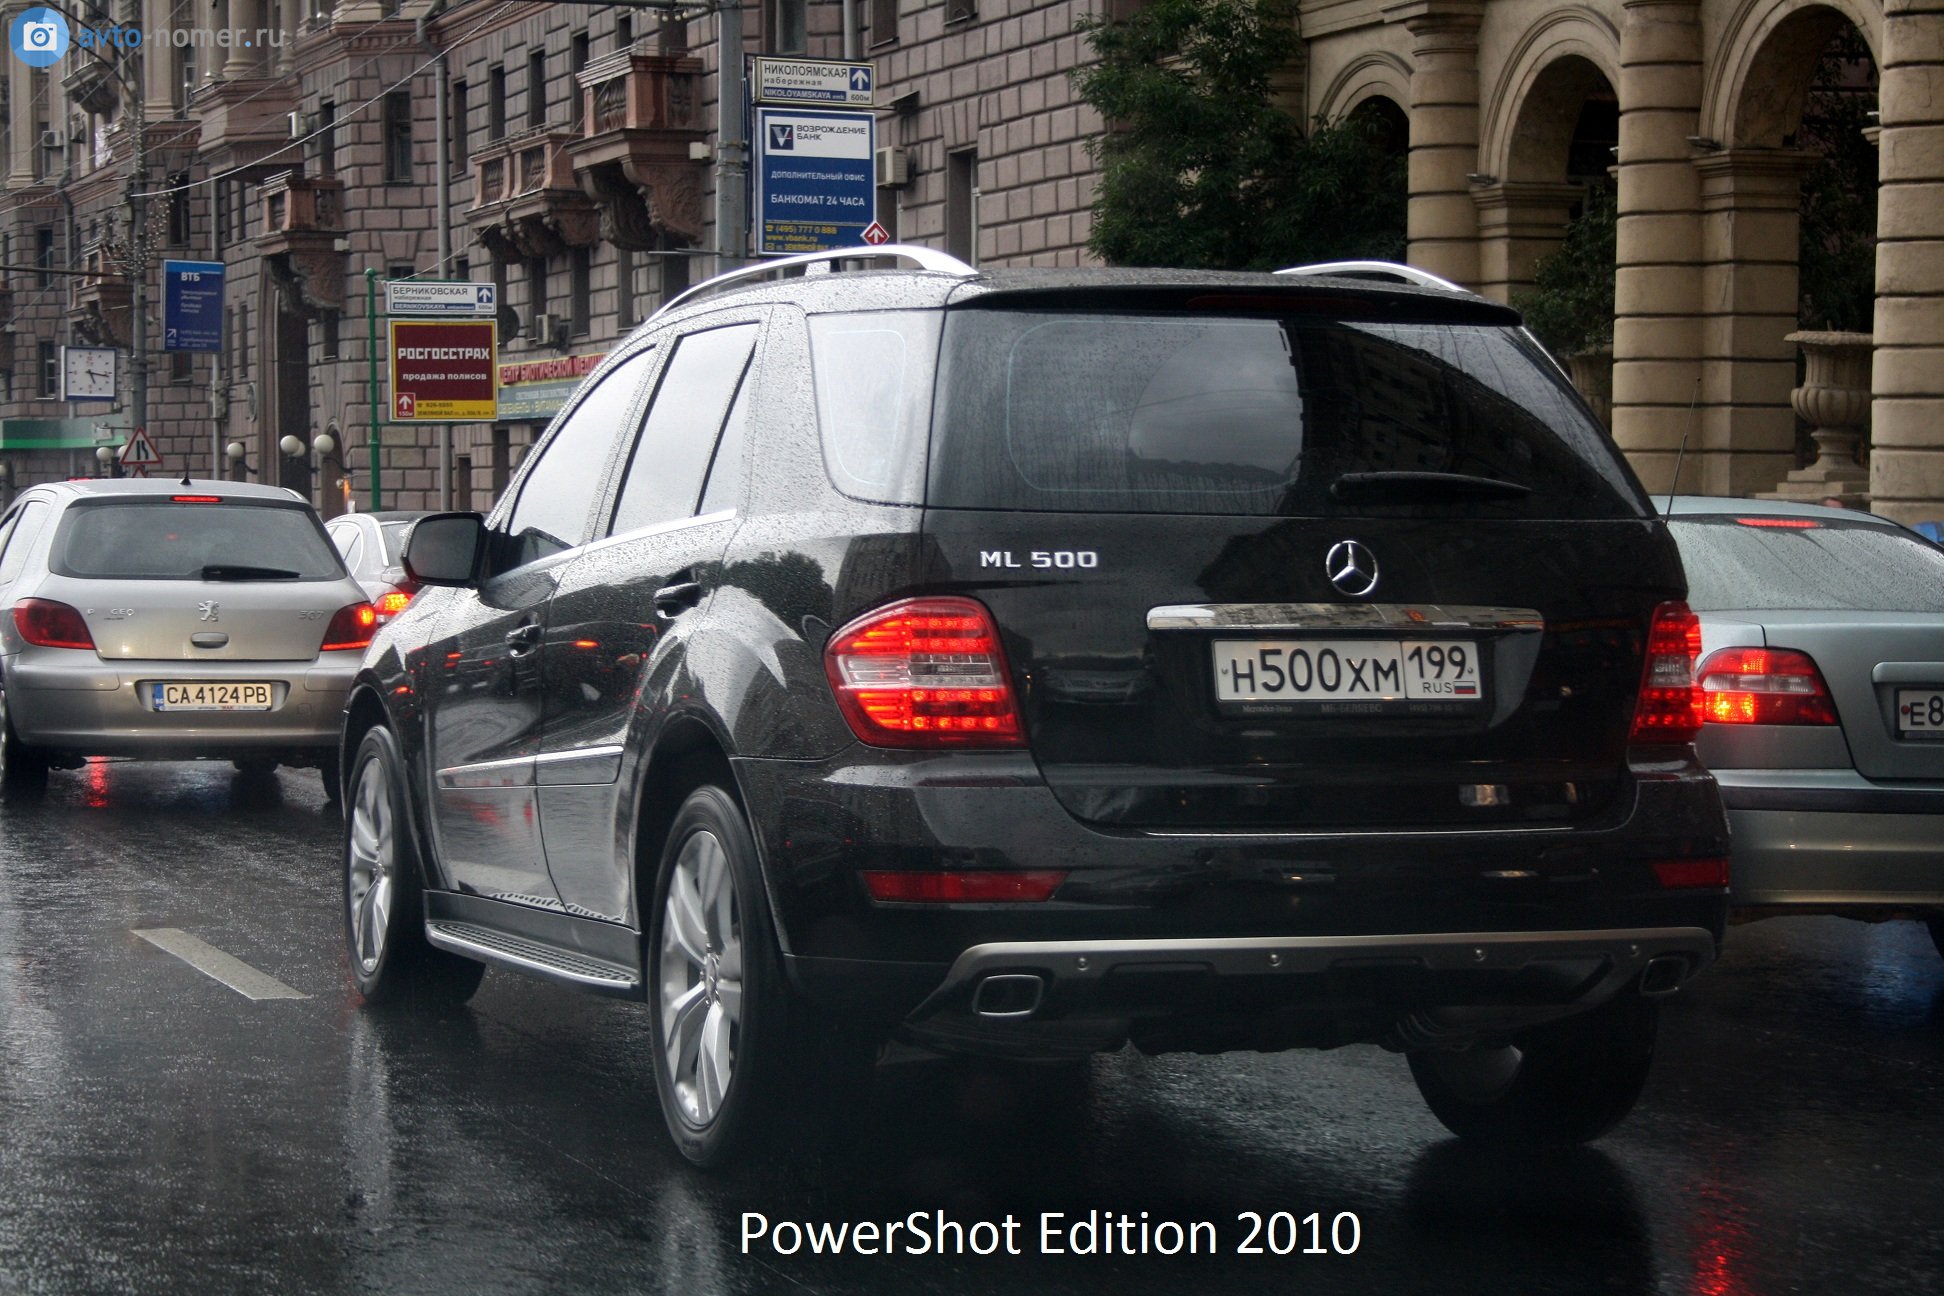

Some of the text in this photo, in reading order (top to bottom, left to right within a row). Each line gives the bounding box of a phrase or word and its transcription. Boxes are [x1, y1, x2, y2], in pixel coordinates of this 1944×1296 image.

[764, 63, 848, 78] НИКОЛОЯМСКАЯ
[764, 76, 823, 86] набережная
[764, 89, 831, 99] NIKOLOYAMSKAYA
[796, 124, 867, 135] ВОЗРОЖДЕНИЕ
[796, 132, 822, 141] БАНК
[771, 170, 865, 182] ДОПОЛНИТЕЛЬНЫЙ ОФИС
[771, 193, 865, 207] БАНКОМАТ 24 ЧАСА
[181, 272, 200, 282] ВТБ
[393, 287, 468, 296] БЕРНИКОВСКАЯ
[397, 347, 490, 360] РОСГОССТРАХ
[402, 373, 487, 382] продажа полисов
[980, 551, 1098, 568] ML 500
[1408, 645, 1466, 679] 199
[1423, 682, 1453, 694] RUS
